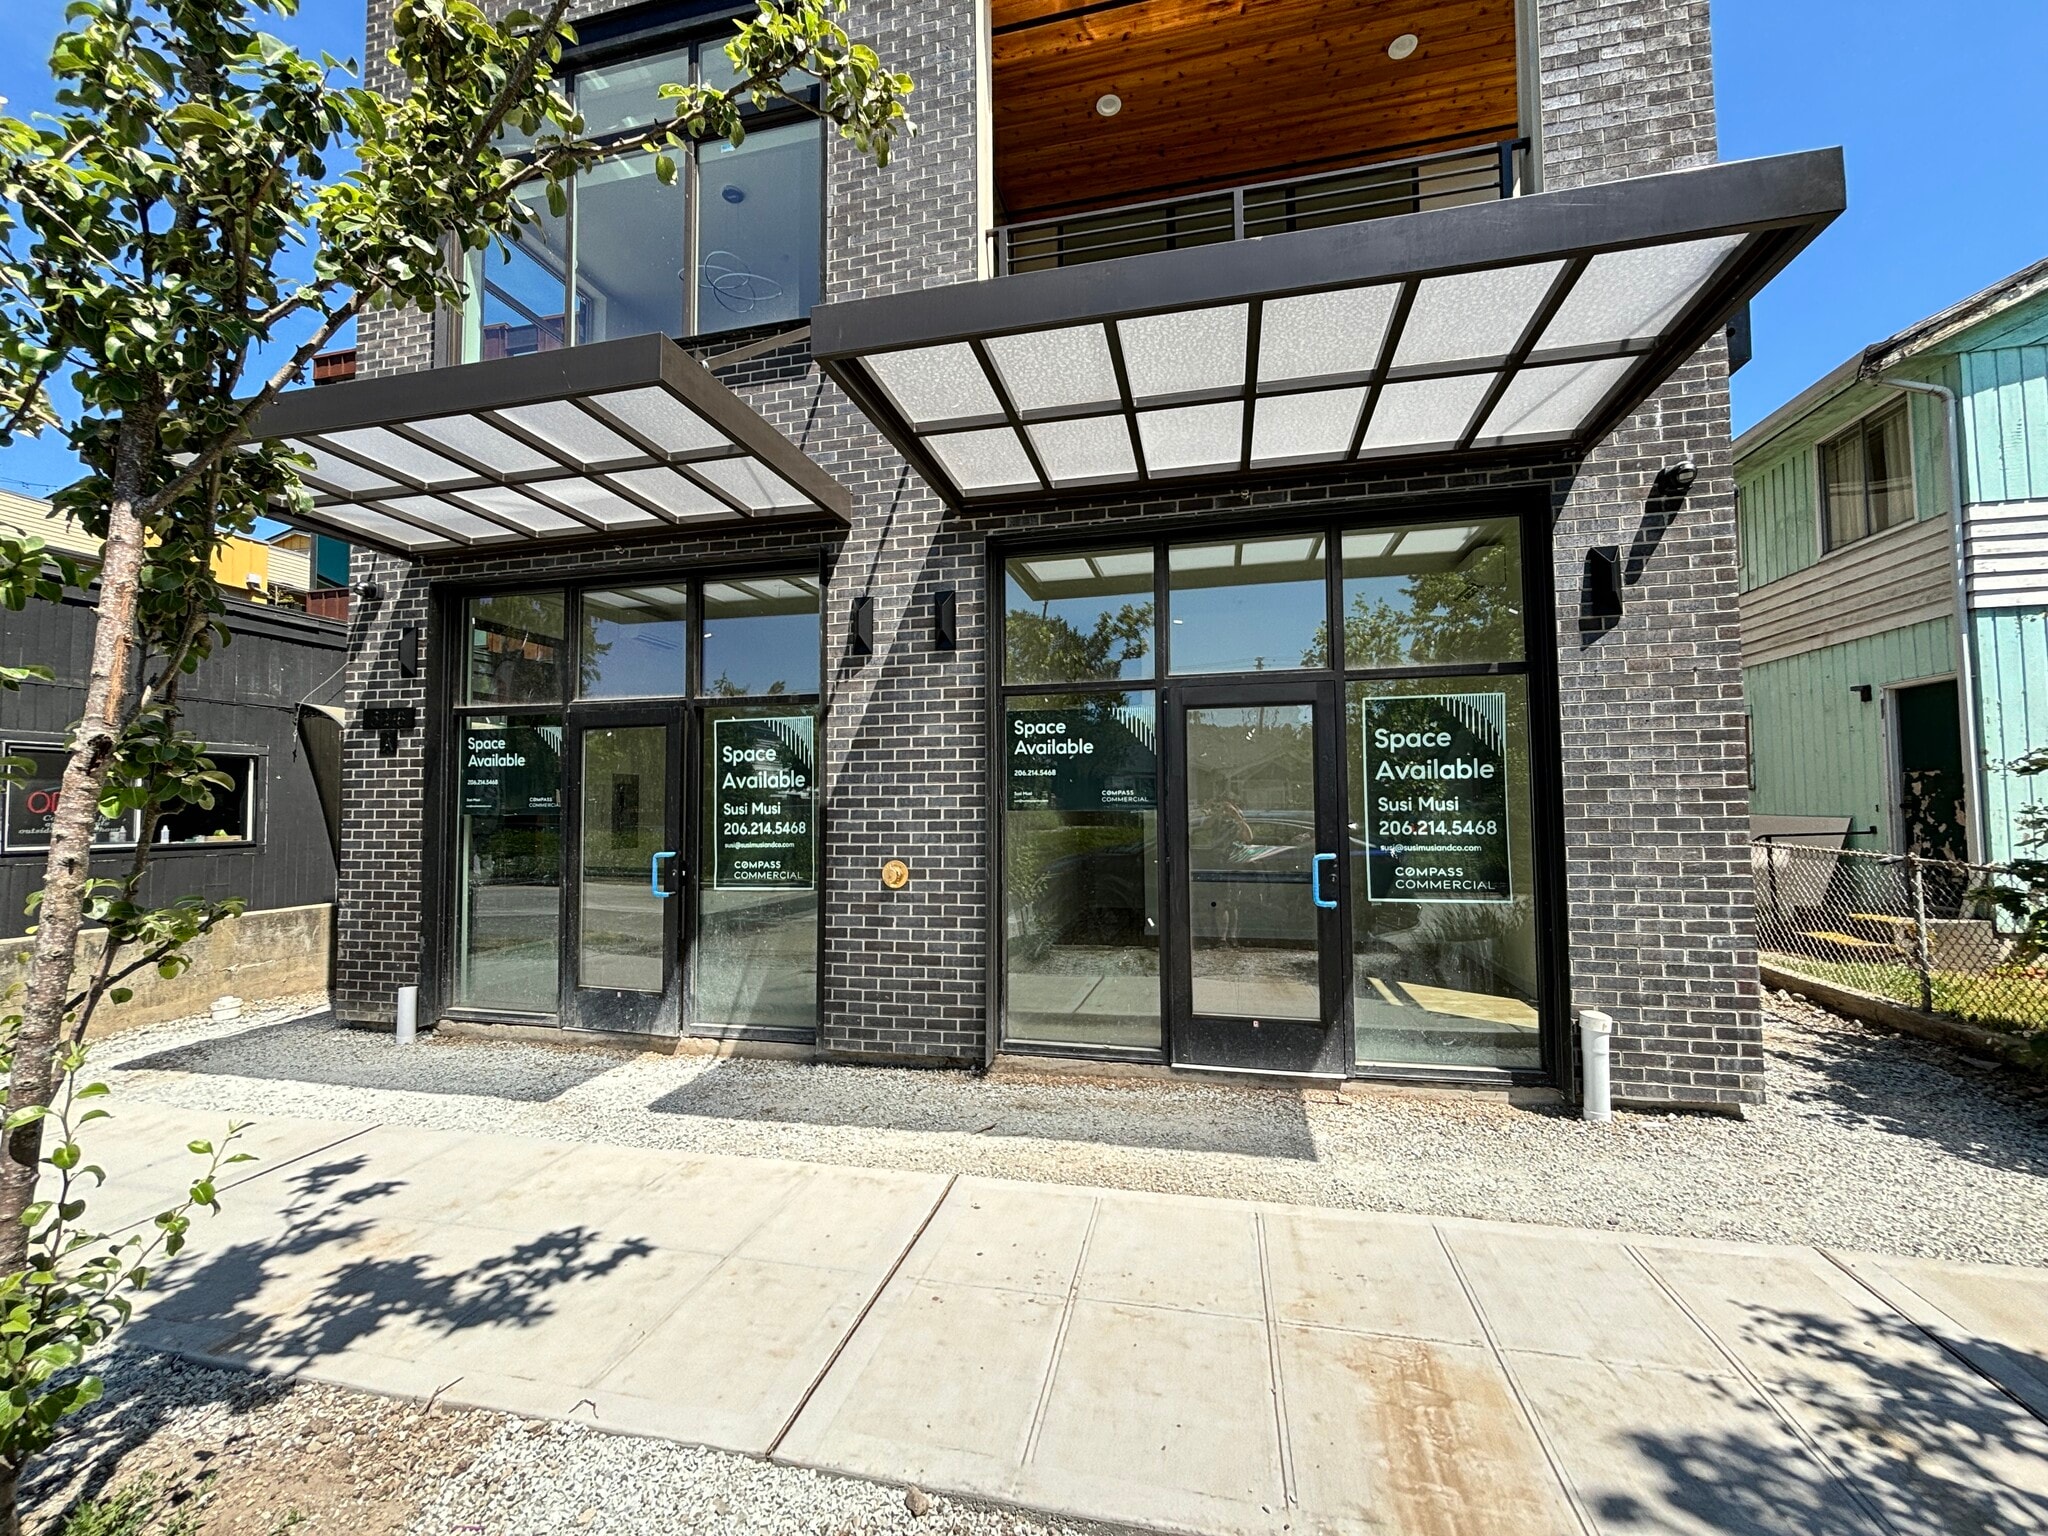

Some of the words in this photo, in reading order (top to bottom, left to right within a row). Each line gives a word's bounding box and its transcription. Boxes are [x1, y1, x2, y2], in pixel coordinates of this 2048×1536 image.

[1014, 720, 1066, 738] Space
[467, 737, 506, 753] Space
[1014, 738, 1094, 755] Available
[1374, 728, 1451, 753] Space
[467, 753, 526, 767] Available
[722, 745, 777, 766] Space
[1014, 769, 1056, 777] 206.214.5468
[1375, 758, 1495, 780] Available
[722, 770, 805, 789] Available
[723, 803, 748, 815] Susi
[752, 802, 781, 815] Musi
[1378, 796, 1412, 812] Susi
[1418, 796, 1459, 811] Musi
[724, 822, 806, 835] 206.214.5468
[1379, 820, 1497, 836] 206.214.5468
[734, 861, 781, 869] COMPASS
[1395, 867, 1463, 877] COMPASS
[734, 871, 804, 880] COMMERCIAL
[1395, 879, 1496, 890] COMMERCIAL
